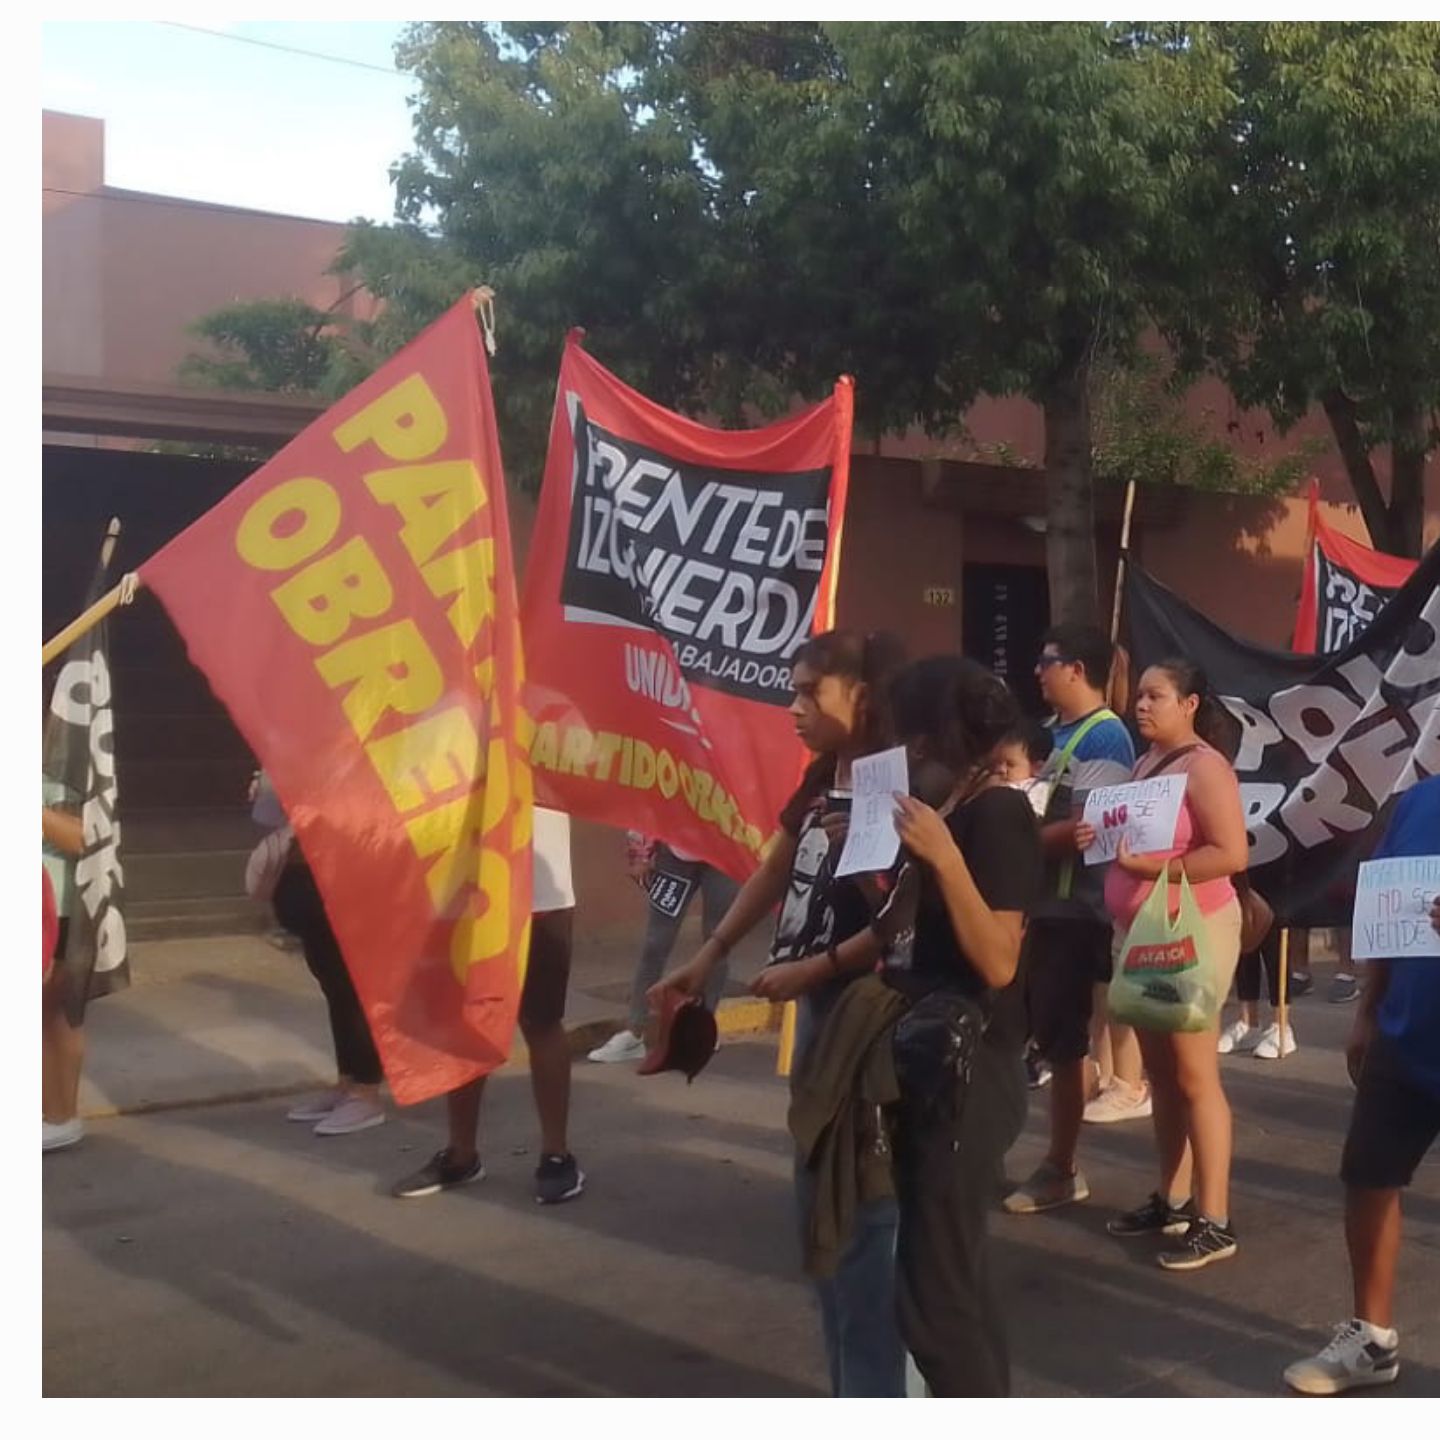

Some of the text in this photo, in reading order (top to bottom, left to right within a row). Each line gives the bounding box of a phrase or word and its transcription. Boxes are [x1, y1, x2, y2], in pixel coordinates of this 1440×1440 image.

[530, 721, 679, 801] ARTIDO
[1102, 803, 1128, 830] NO
[1377, 889, 1402, 918] NO
